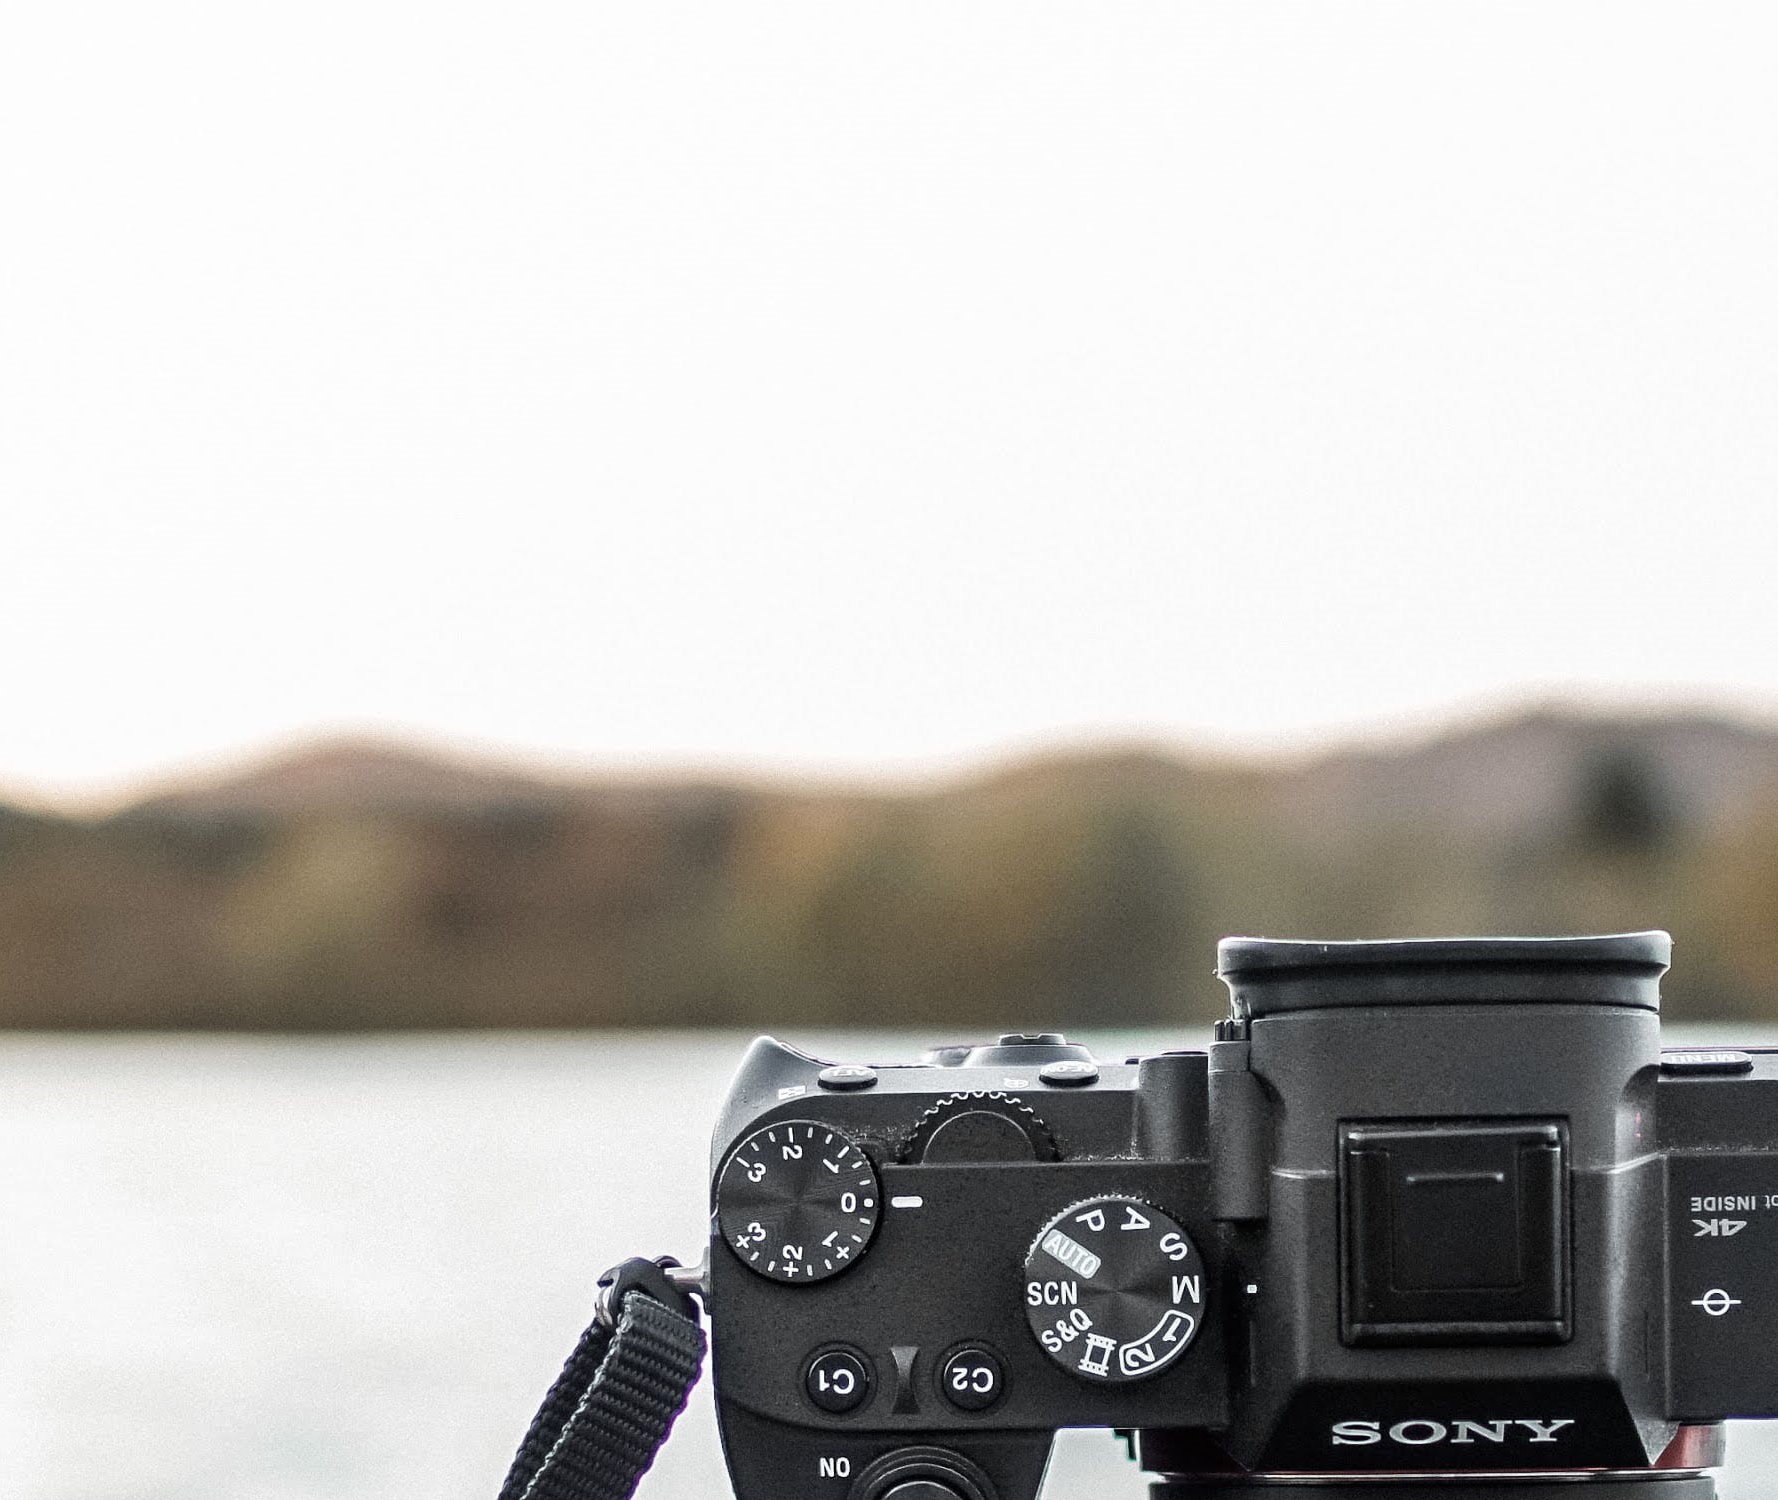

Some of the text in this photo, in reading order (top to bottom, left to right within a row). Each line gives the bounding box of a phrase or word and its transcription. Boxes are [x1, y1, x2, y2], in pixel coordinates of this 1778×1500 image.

[841, 1192, 856, 1213] 0
[1691, 1196, 1756, 1212] INSIDE
[1075, 1209, 1105, 1232] P
[1120, 1206, 1151, 1231] A
[1691, 1218, 1748, 1237] 4K
[736, 1222, 767, 1249] +3
[822, 1231, 850, 1259] +1
[1159, 1232, 1188, 1261] S
[782, 1244, 803, 1277] +2
[1044, 1233, 1098, 1278] AUTO
[1027, 1281, 1078, 1306] SCN
[1171, 1275, 1200, 1304] M
[1041, 1308, 1093, 1352] S&Q
[818, 1368, 855, 1395] C1
[952, 1367, 995, 1393] C2
[1331, 1419, 1575, 1446] SONY
[820, 1457, 851, 1478] ON
